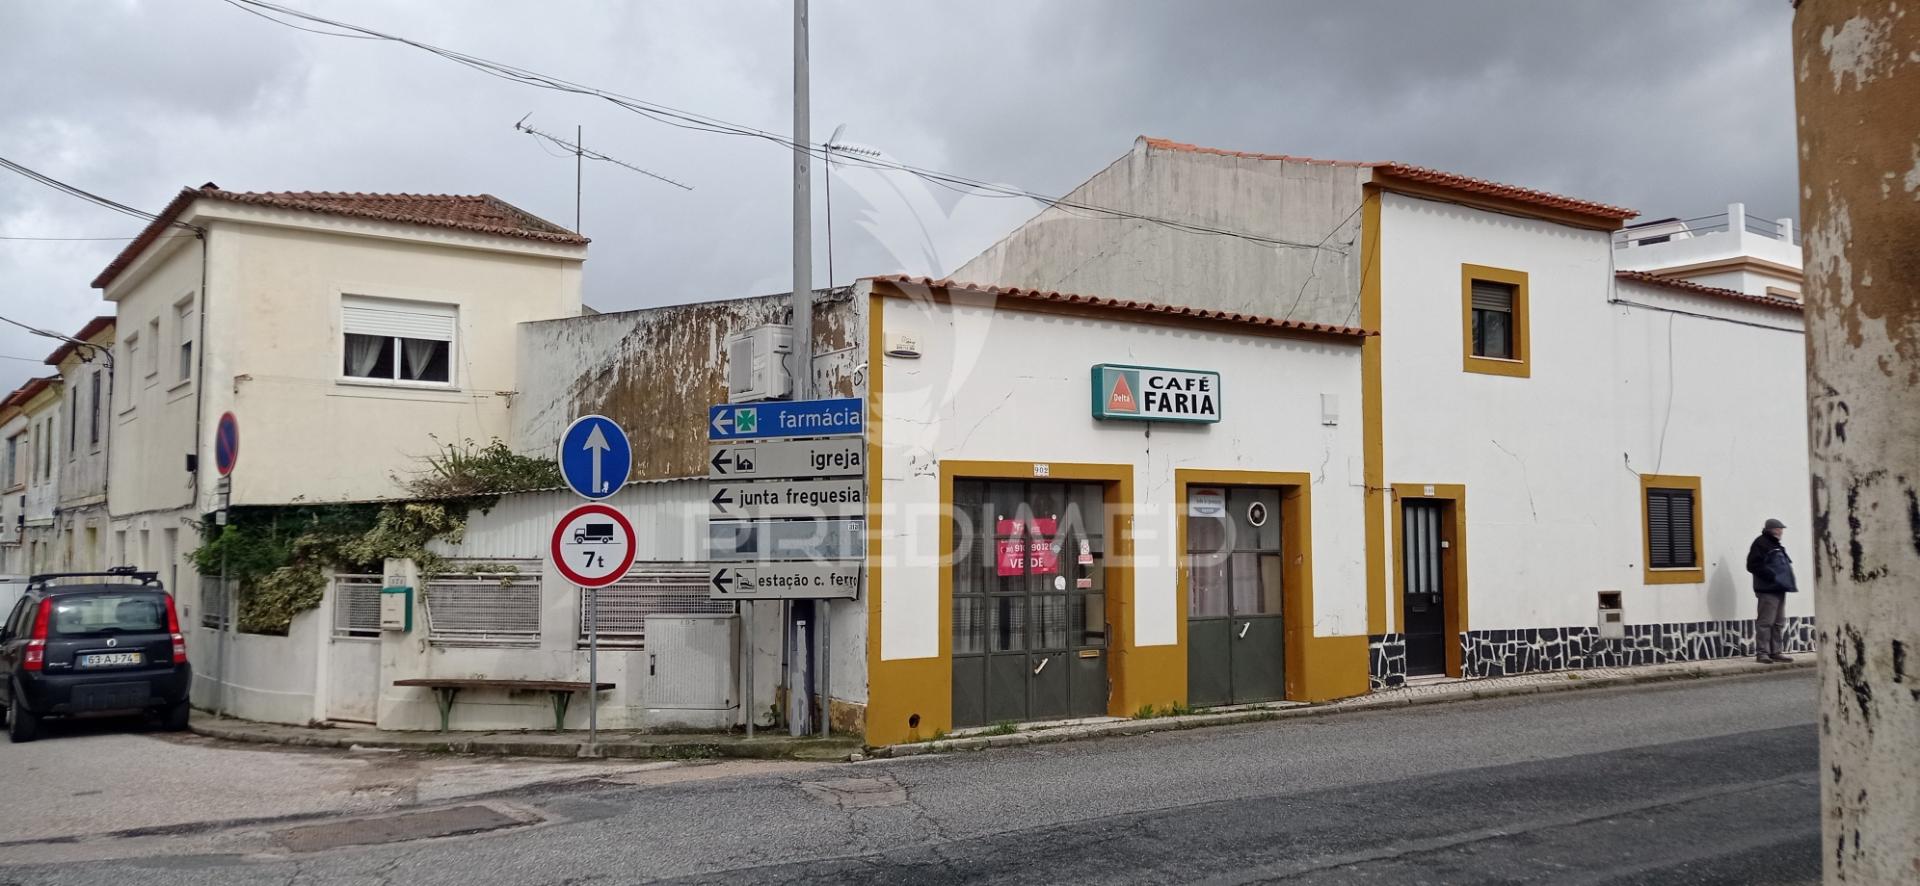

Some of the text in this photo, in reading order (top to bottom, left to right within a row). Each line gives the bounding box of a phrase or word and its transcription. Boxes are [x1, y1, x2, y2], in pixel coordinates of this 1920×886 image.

[1148, 376, 1211, 393] CAFÉ
[1113, 393, 1131, 403] Delta
[1144, 390, 1215, 415] FARIA
[779, 408, 860, 428] farmácia
[810, 449, 860, 470] igreja
[738, 486, 861, 508] junta freguesia
[1010, 557, 1044, 568] VEDE
[758, 573, 809, 590] estação
[814, 575, 825, 586] c.
